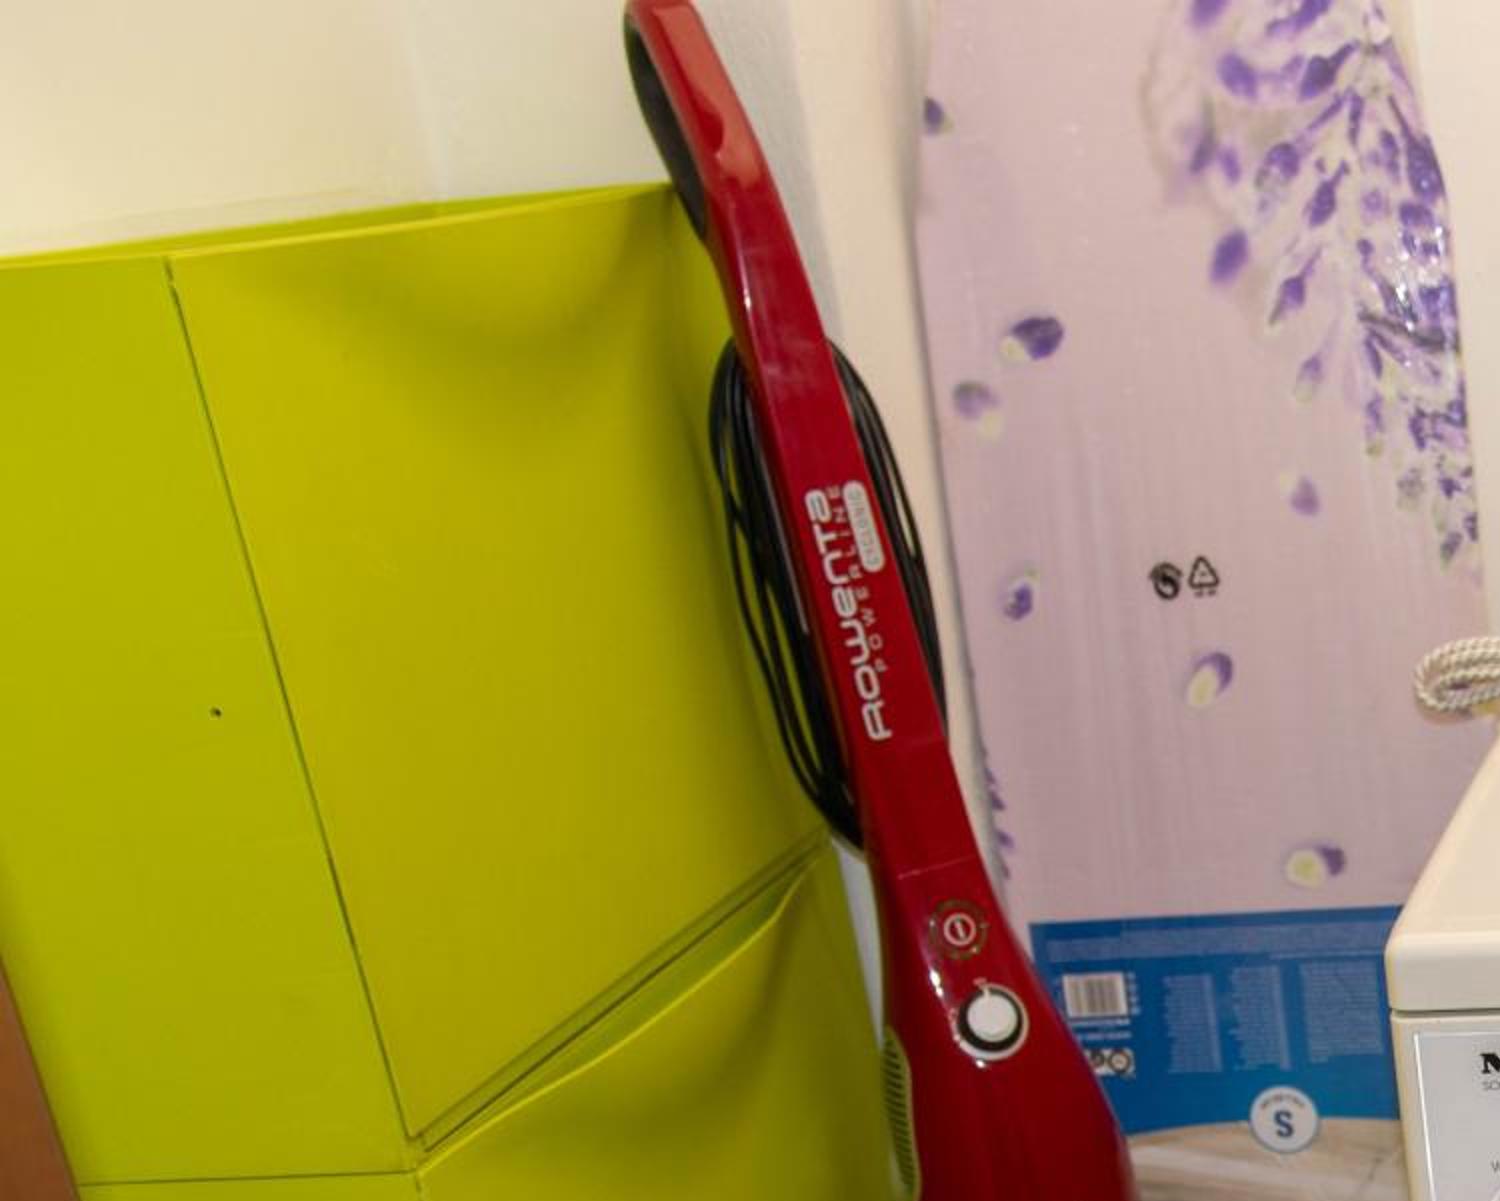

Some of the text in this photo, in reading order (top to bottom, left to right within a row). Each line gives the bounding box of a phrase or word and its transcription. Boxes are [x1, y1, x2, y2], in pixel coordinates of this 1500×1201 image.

[804, 488, 893, 741] Rowenta
[825, 486, 888, 673] POWERLINE
[1274, 1110, 1294, 1137] S
